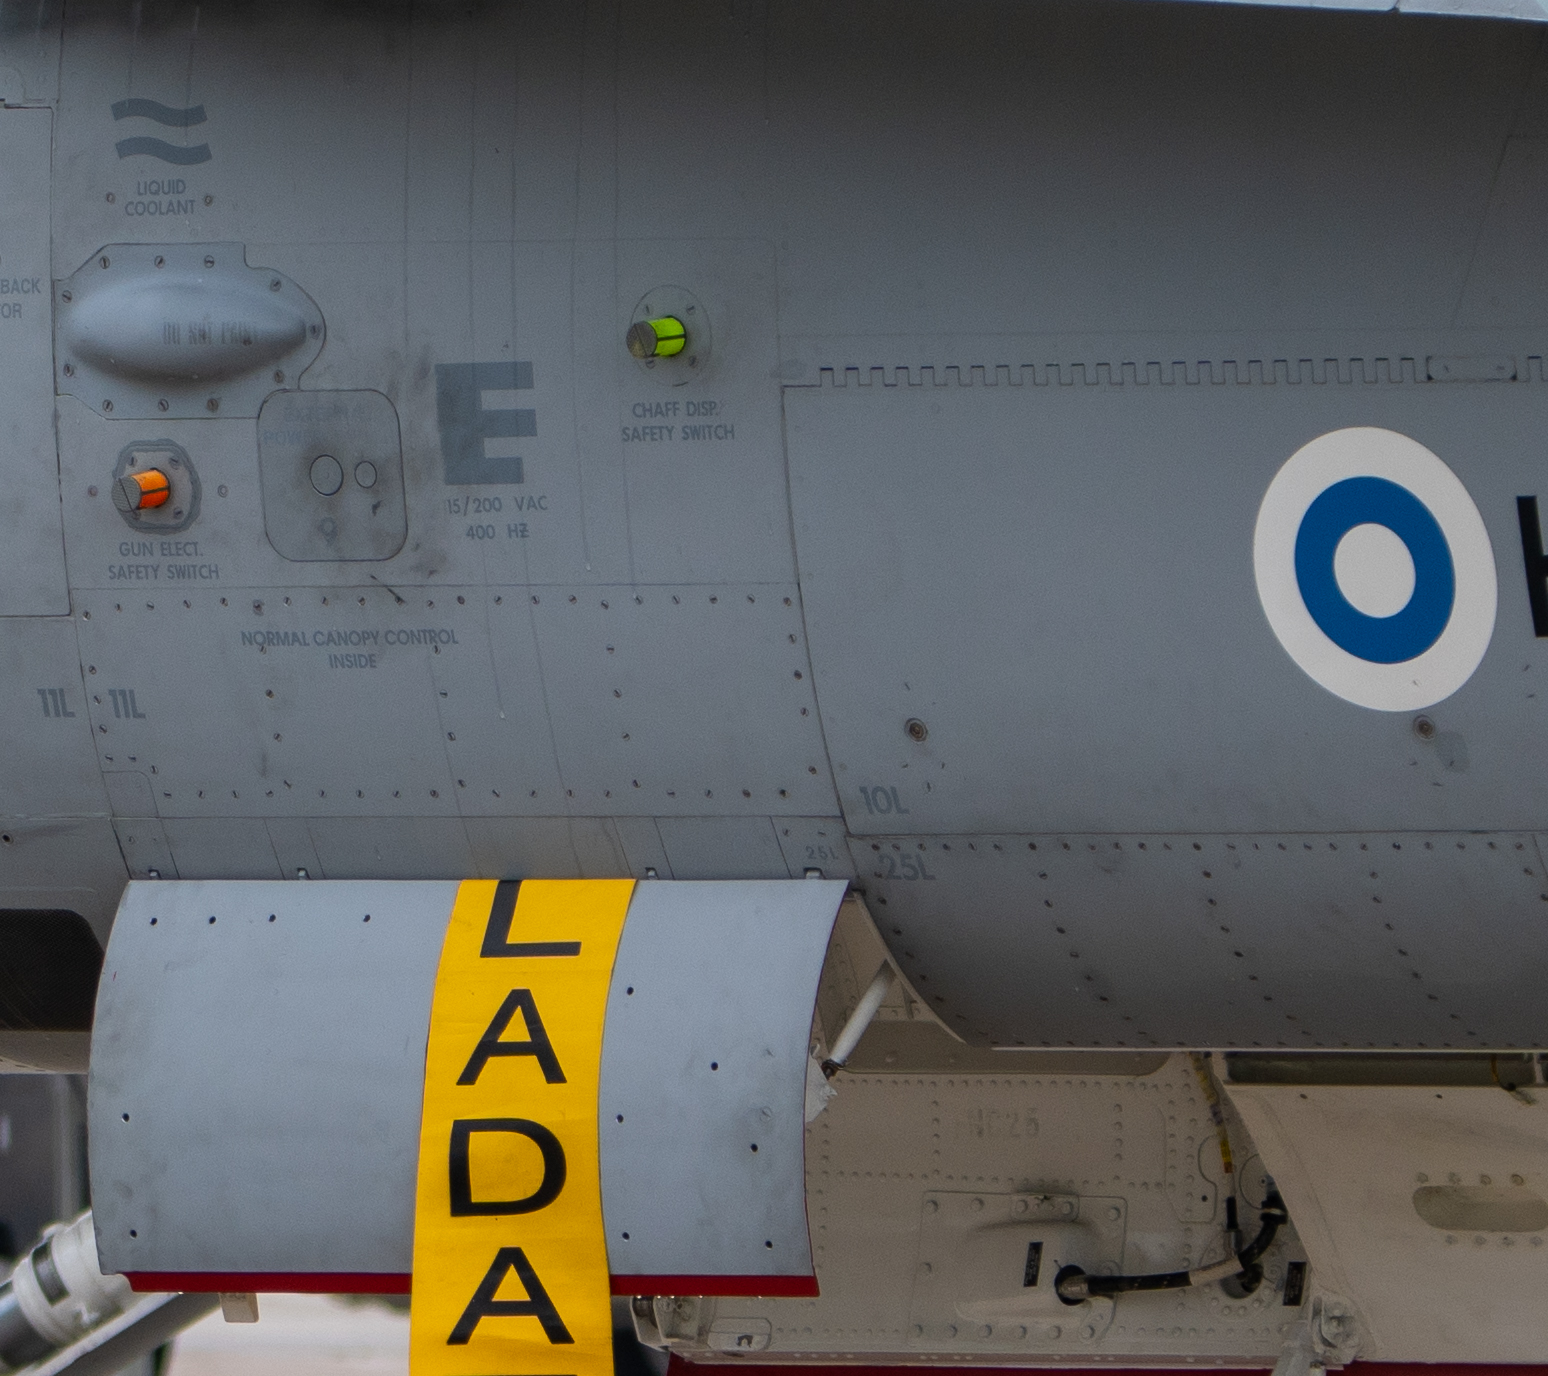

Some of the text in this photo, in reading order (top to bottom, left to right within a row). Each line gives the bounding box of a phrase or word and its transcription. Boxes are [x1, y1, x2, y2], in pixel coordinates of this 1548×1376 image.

[137, 179, 186, 195] LIQUID
[125, 199, 196, 216] COOLANT
[632, 401, 681, 418] CHAFF
[434, 361, 538, 486] E
[622, 424, 735, 442] SAFETY SWITCH
[514, 495, 549, 512] VAC
[465, 523, 530, 540] 400 HZ
[119, 542, 154, 557] GUN
[108, 564, 220, 580] SAFETY SWITCH
[241, 629, 459, 647] NORMAL CANOPY CONTROL
[329, 653, 377, 669] INSIDE
[37, 688, 76, 718] 11L
[108, 689, 146, 719] 11L
[859, 786, 909, 815] 10L
[806, 845, 839, 860] 25L
[878, 852, 936, 882] 25L
